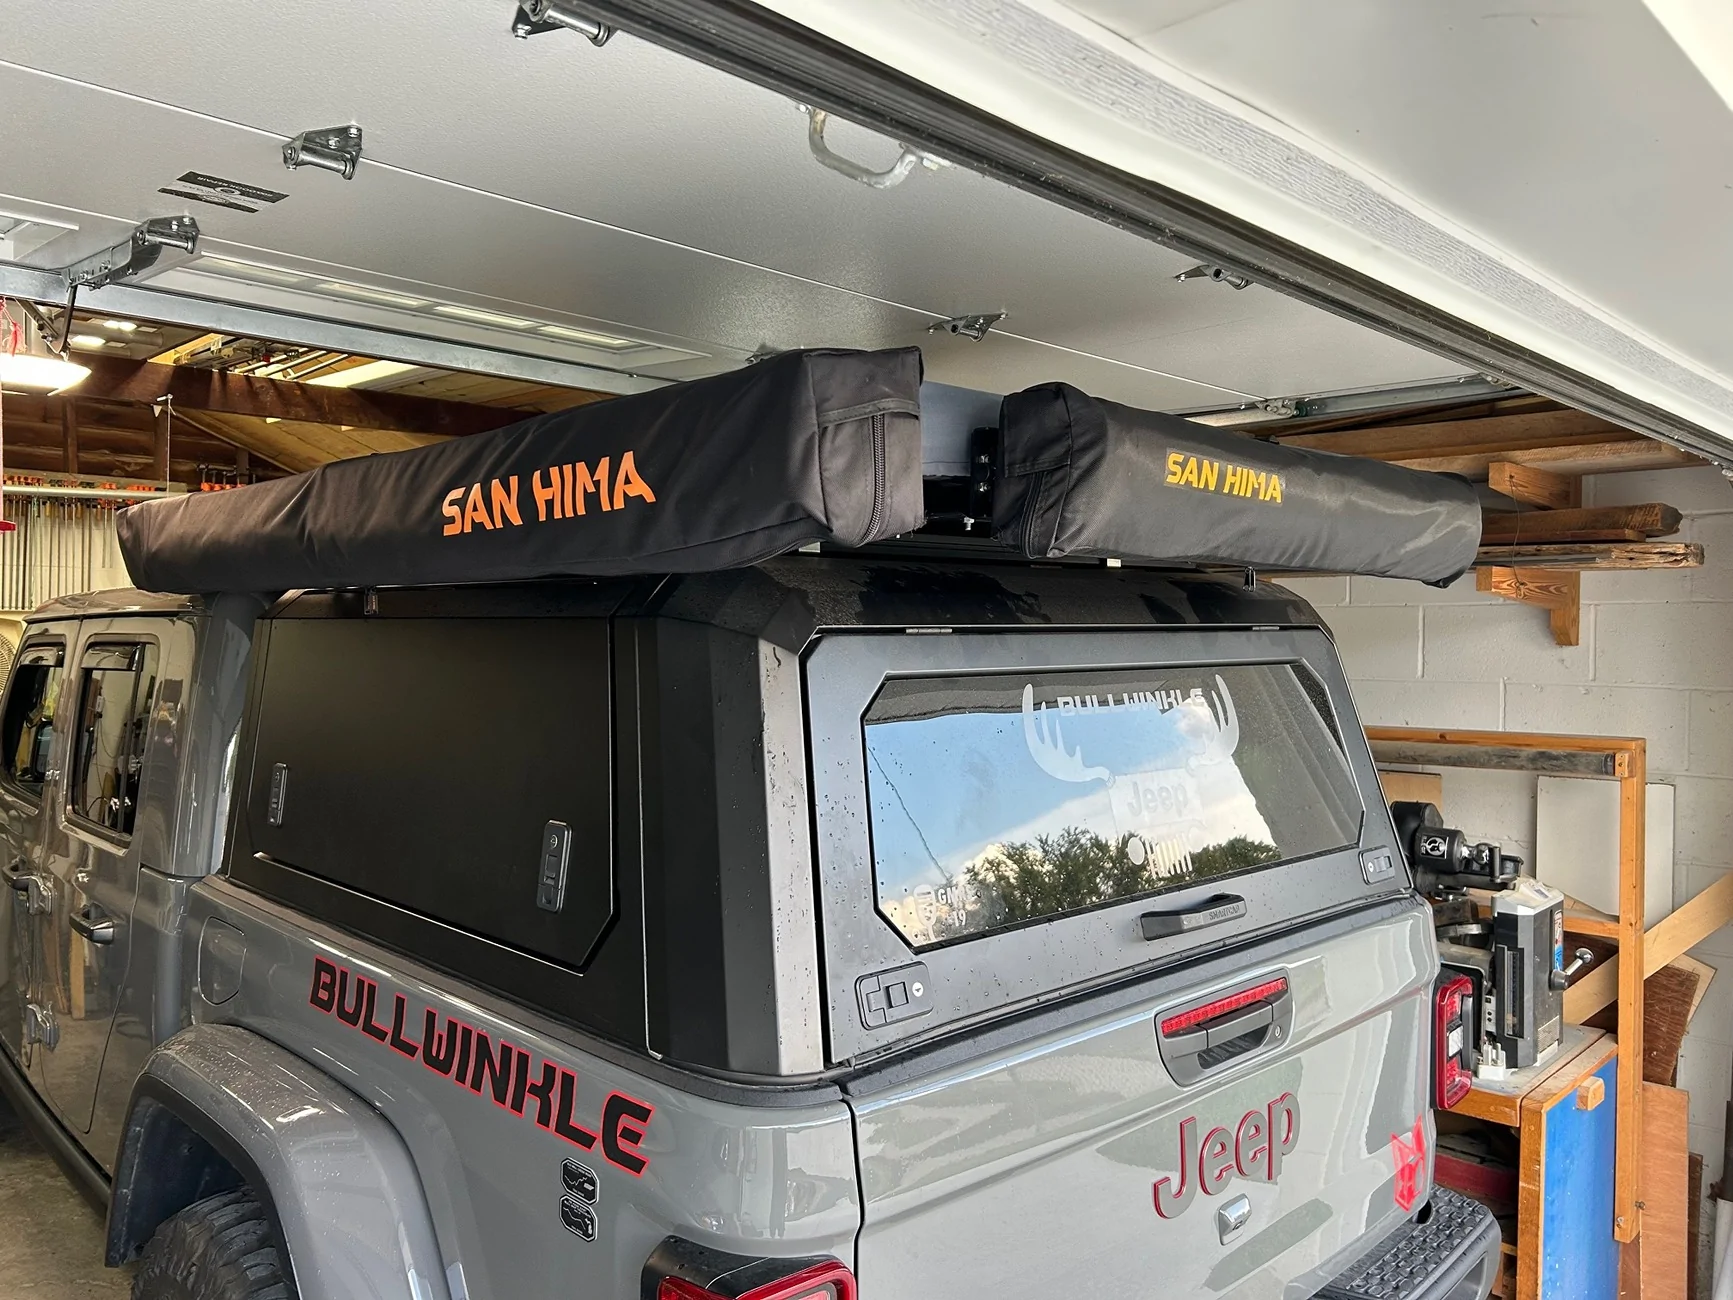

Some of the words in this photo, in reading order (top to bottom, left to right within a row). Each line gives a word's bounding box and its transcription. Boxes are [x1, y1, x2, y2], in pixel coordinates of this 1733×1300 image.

[442, 475, 523, 536] SAN
[532, 450, 656, 522] HIMA
[1166, 452, 1219, 491] SAN
[1223, 464, 1281, 503] HIMA
[1057, 688, 1203, 716] BULLWINKLE
[1127, 781, 1188, 817] Jeep
[309, 954, 654, 1178] BULLWINKLE
[1154, 1092, 1300, 1219] Jeep
